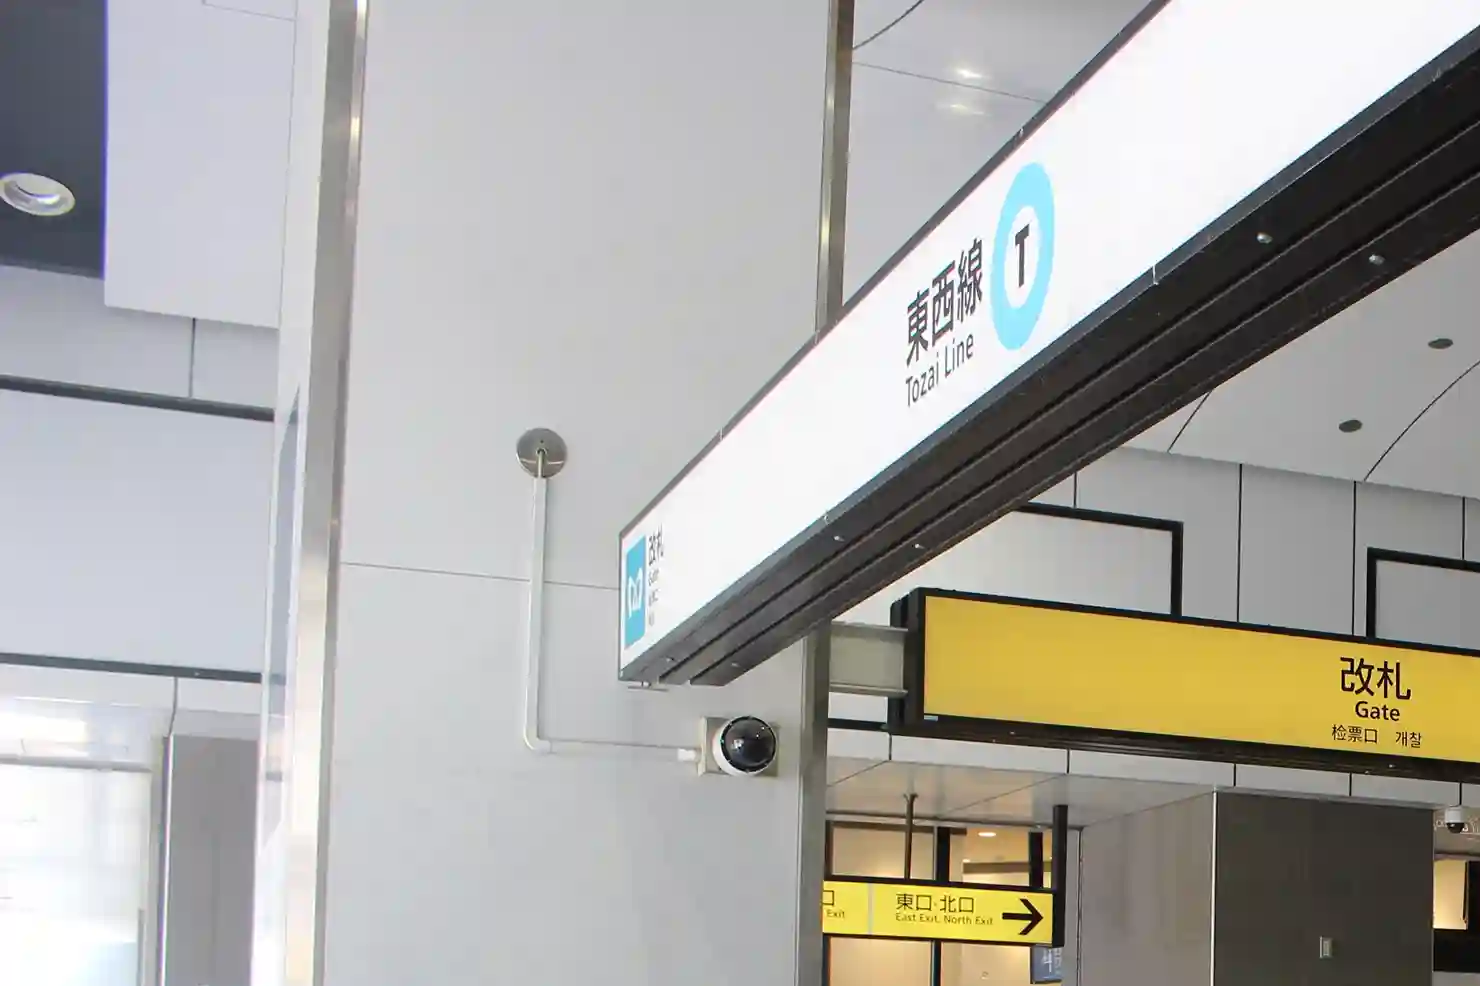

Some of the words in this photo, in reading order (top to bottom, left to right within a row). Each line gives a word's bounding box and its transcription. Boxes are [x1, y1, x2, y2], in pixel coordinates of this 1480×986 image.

[1014, 223, 1030, 288] T
[905, 237, 983, 367] 東西線
[905, 351, 940, 407] Tozai
[944, 333, 975, 379] Line
[1340, 656, 1411, 700] 改札
[1355, 701, 1401, 721] Gate
[1332, 724, 1379, 744] 检票口
[1395, 731, 1422, 748] 개찰
[826, 909, 845, 919] Exit
[895, 912, 917, 922] East
[944, 915, 972, 925] North
[975, 916, 993, 926] Exit
